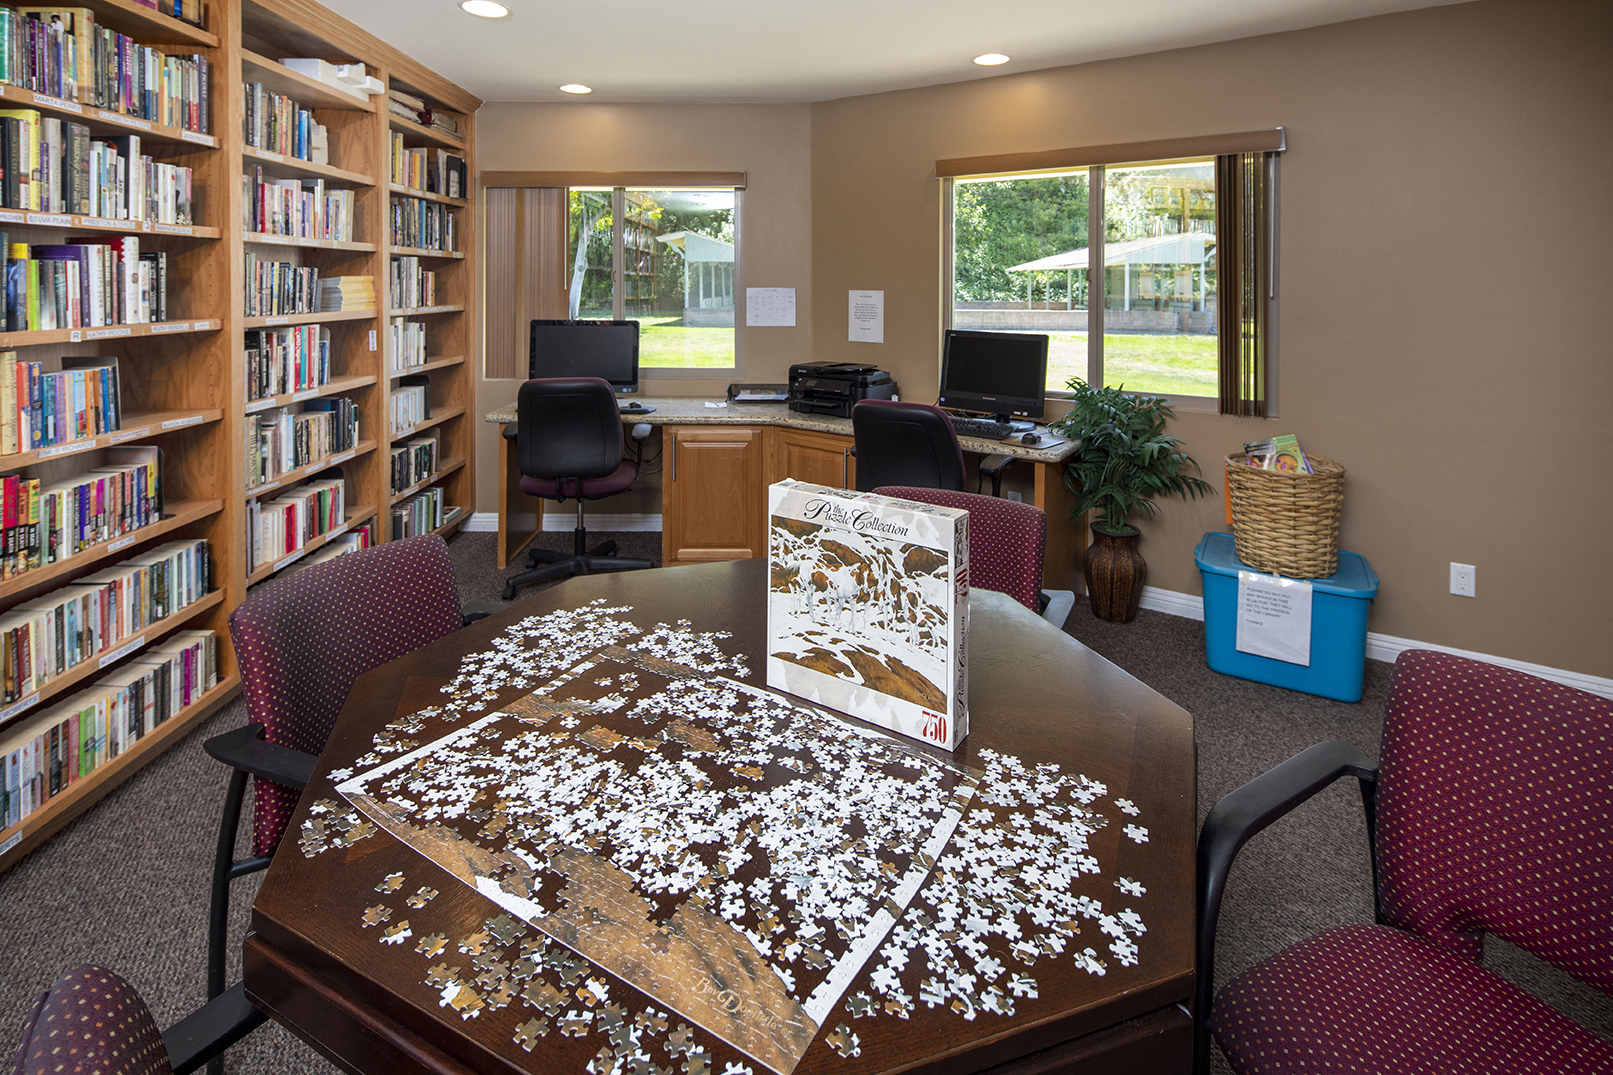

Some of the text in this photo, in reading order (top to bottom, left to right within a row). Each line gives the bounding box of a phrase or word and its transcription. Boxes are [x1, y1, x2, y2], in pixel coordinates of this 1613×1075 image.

[34, 94, 81, 112] MARTA PERRY
[52, 217, 71, 225] PLAIN
[84, 218, 112, 226] PRESTON
[73, 331, 79, 339] R
[87, 330, 107, 338] KATHY
[803, 498, 910, 537] the Puzzle Collection
[954, 567, 968, 605] 750
[100, 639, 145, 667] NORA ROBERTS
[957, 616, 967, 668] Collection
[3, 696, 38, 718] ROBERTS
[921, 710, 948, 744] 750
[716, 989, 777, 1031] Doolittle
